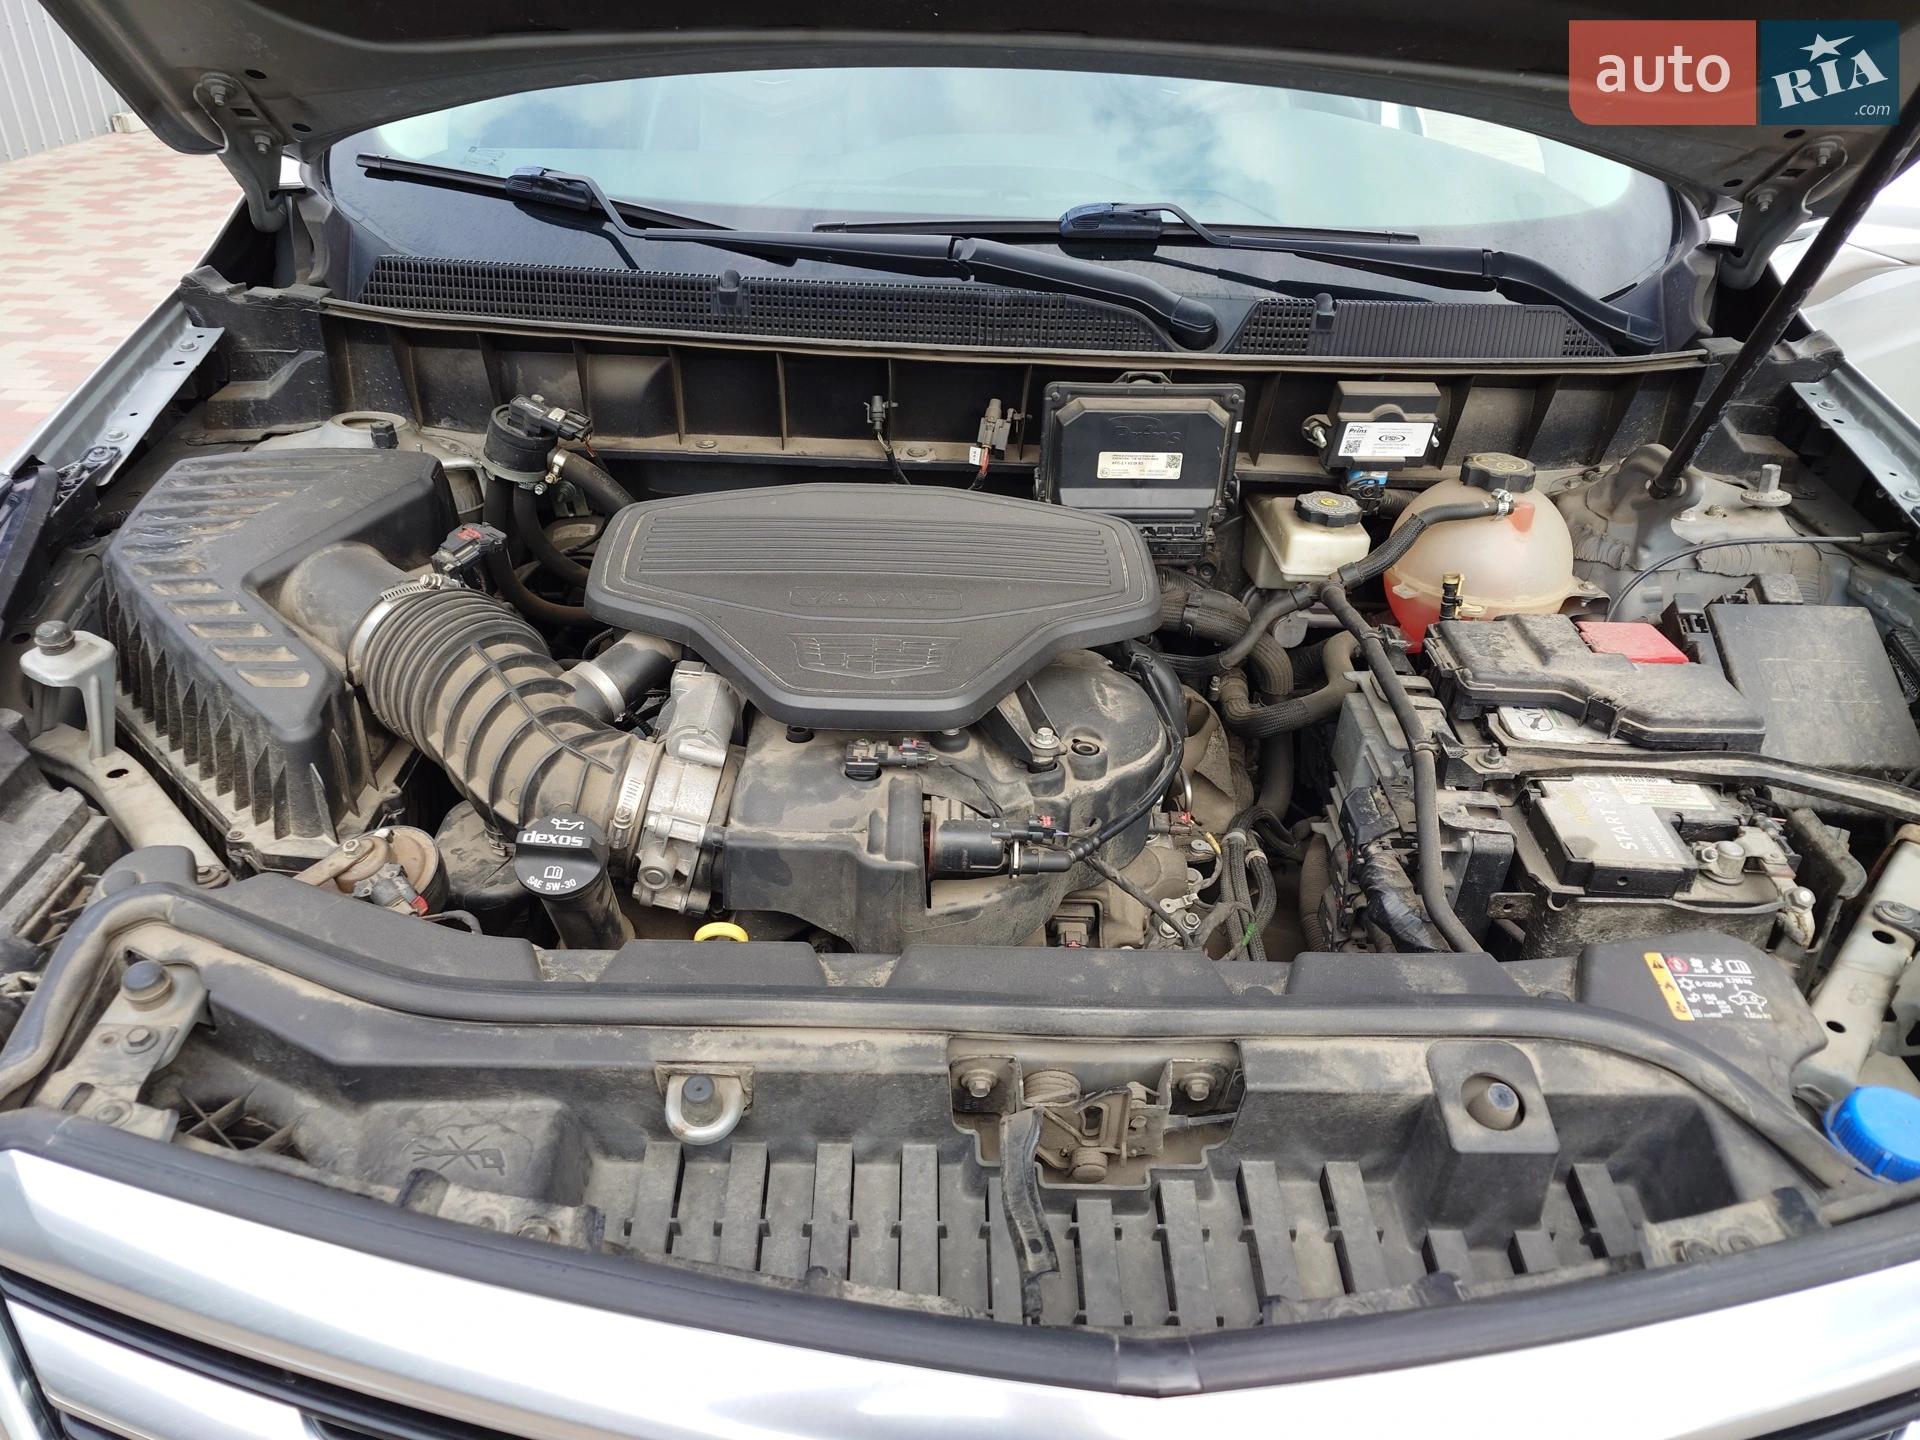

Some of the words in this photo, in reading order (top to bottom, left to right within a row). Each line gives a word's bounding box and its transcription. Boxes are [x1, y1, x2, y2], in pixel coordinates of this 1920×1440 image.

[1581, 777, 1609, 804] STO
[522, 831, 583, 846] dexos
[1600, 808, 1639, 850] START
[527, 876, 543, 888] SAE
[545, 878, 576, 891] 5W-30
